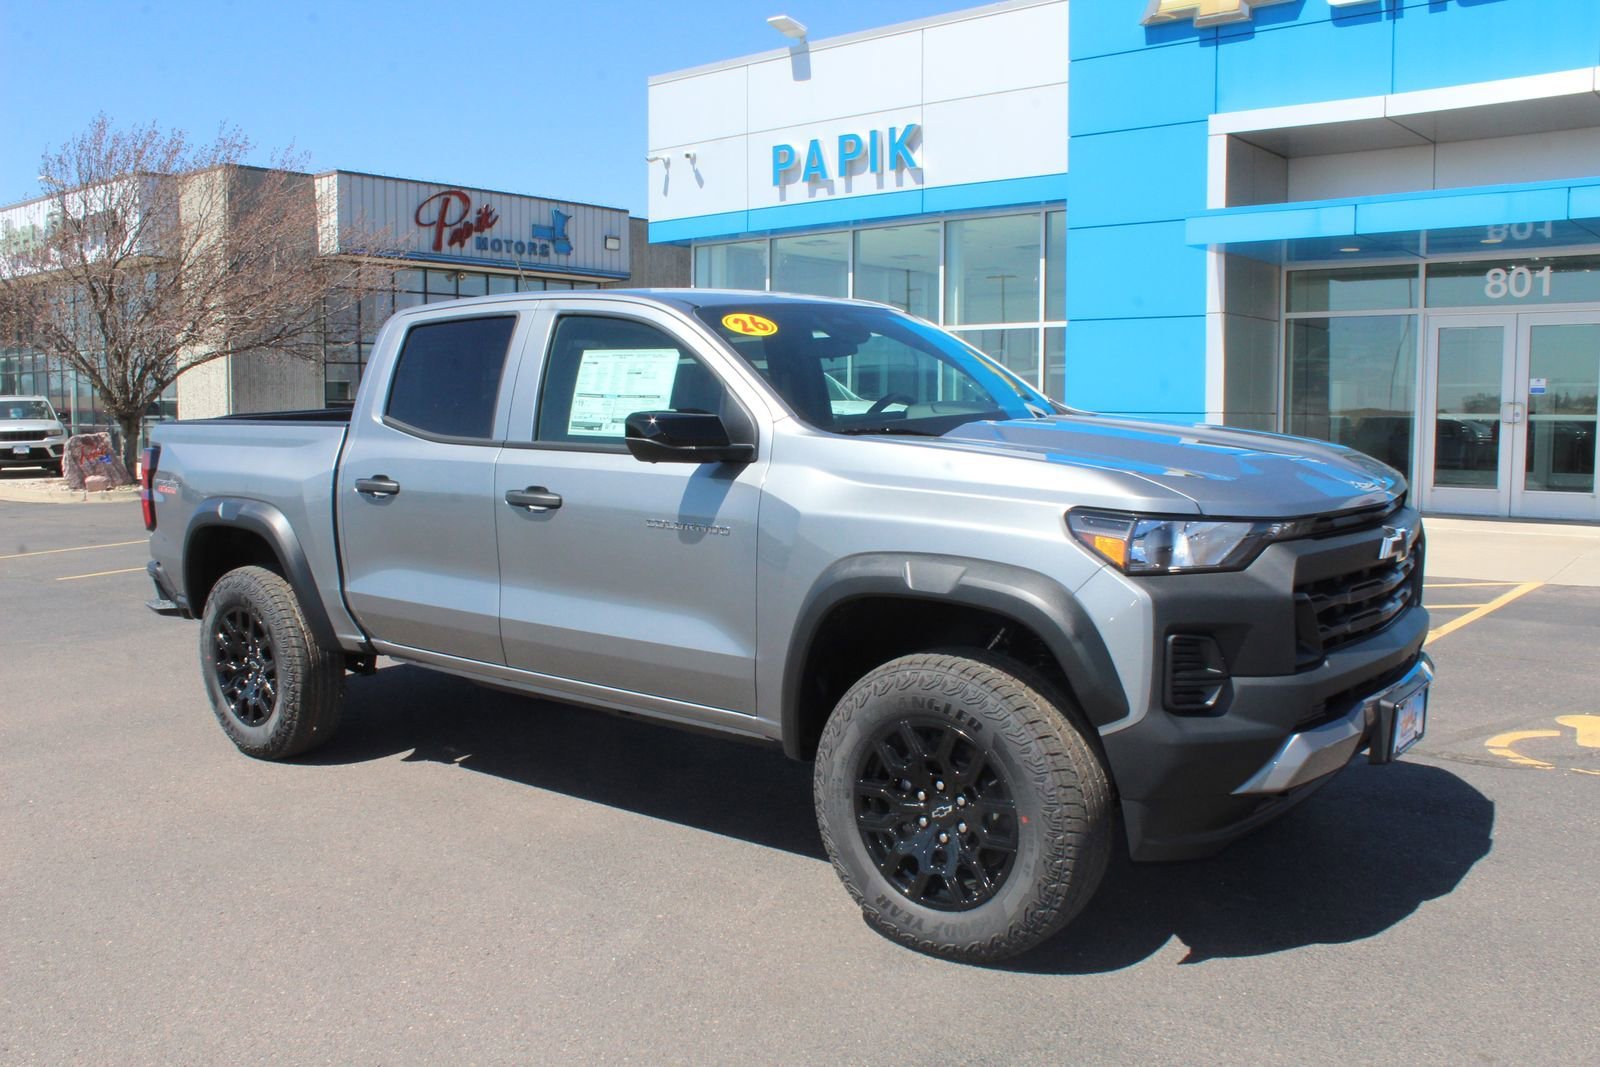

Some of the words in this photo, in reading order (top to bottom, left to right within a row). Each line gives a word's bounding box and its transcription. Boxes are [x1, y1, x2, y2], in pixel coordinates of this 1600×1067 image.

[772, 123, 921, 188] PAPIK
[475, 236, 550, 257] MOTORS
[1484, 265, 1551, 299] 801
